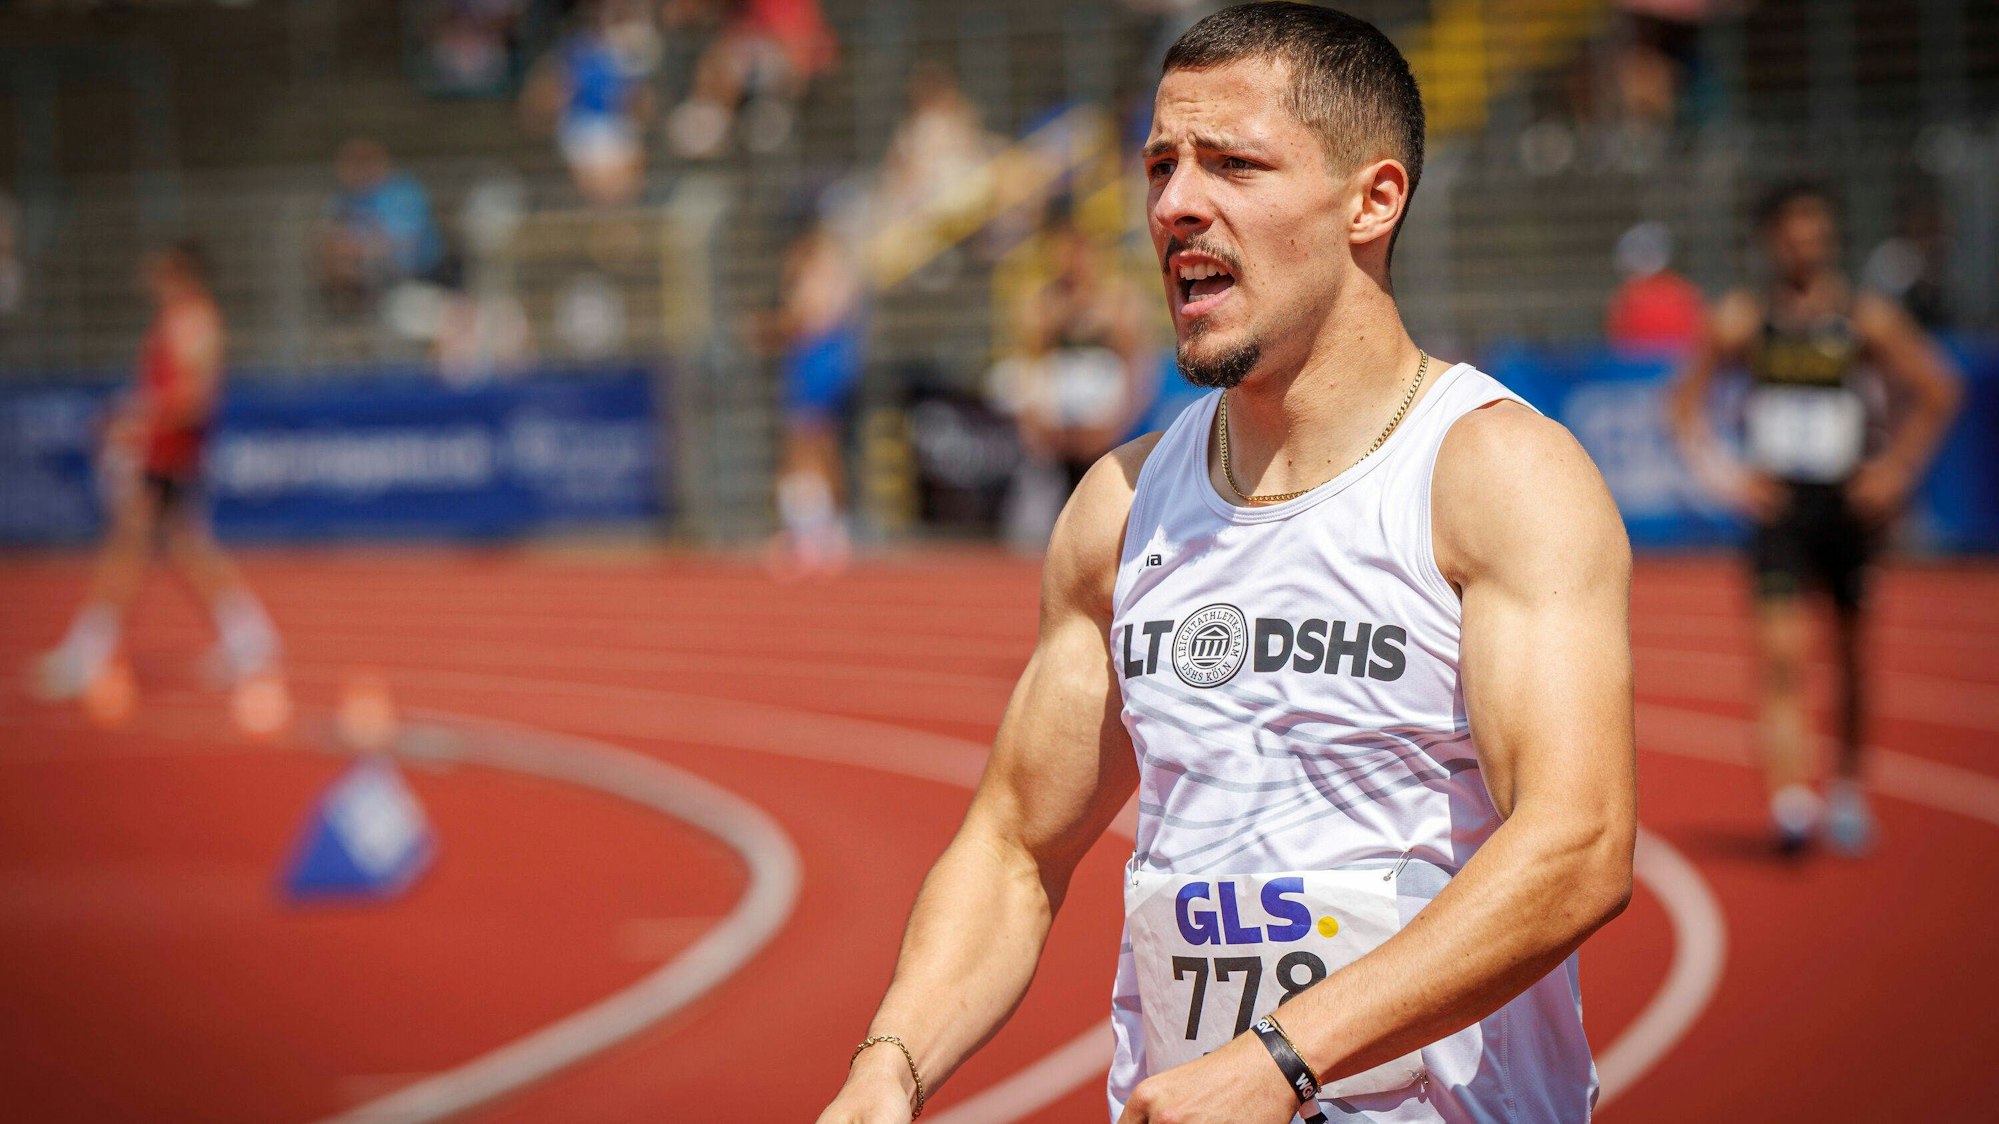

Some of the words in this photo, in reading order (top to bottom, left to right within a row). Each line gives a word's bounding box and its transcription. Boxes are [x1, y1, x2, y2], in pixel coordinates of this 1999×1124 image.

[1123, 619, 1175, 680] LT
[1254, 617, 1407, 682] DSHS
[1178, 610, 1242, 659] LEICHTATHLETIK-TEAM
[1181, 662, 1204, 682] DSHS
[1206, 660, 1232, 682] KÖLN
[1295, 1072, 1317, 1100] WG
